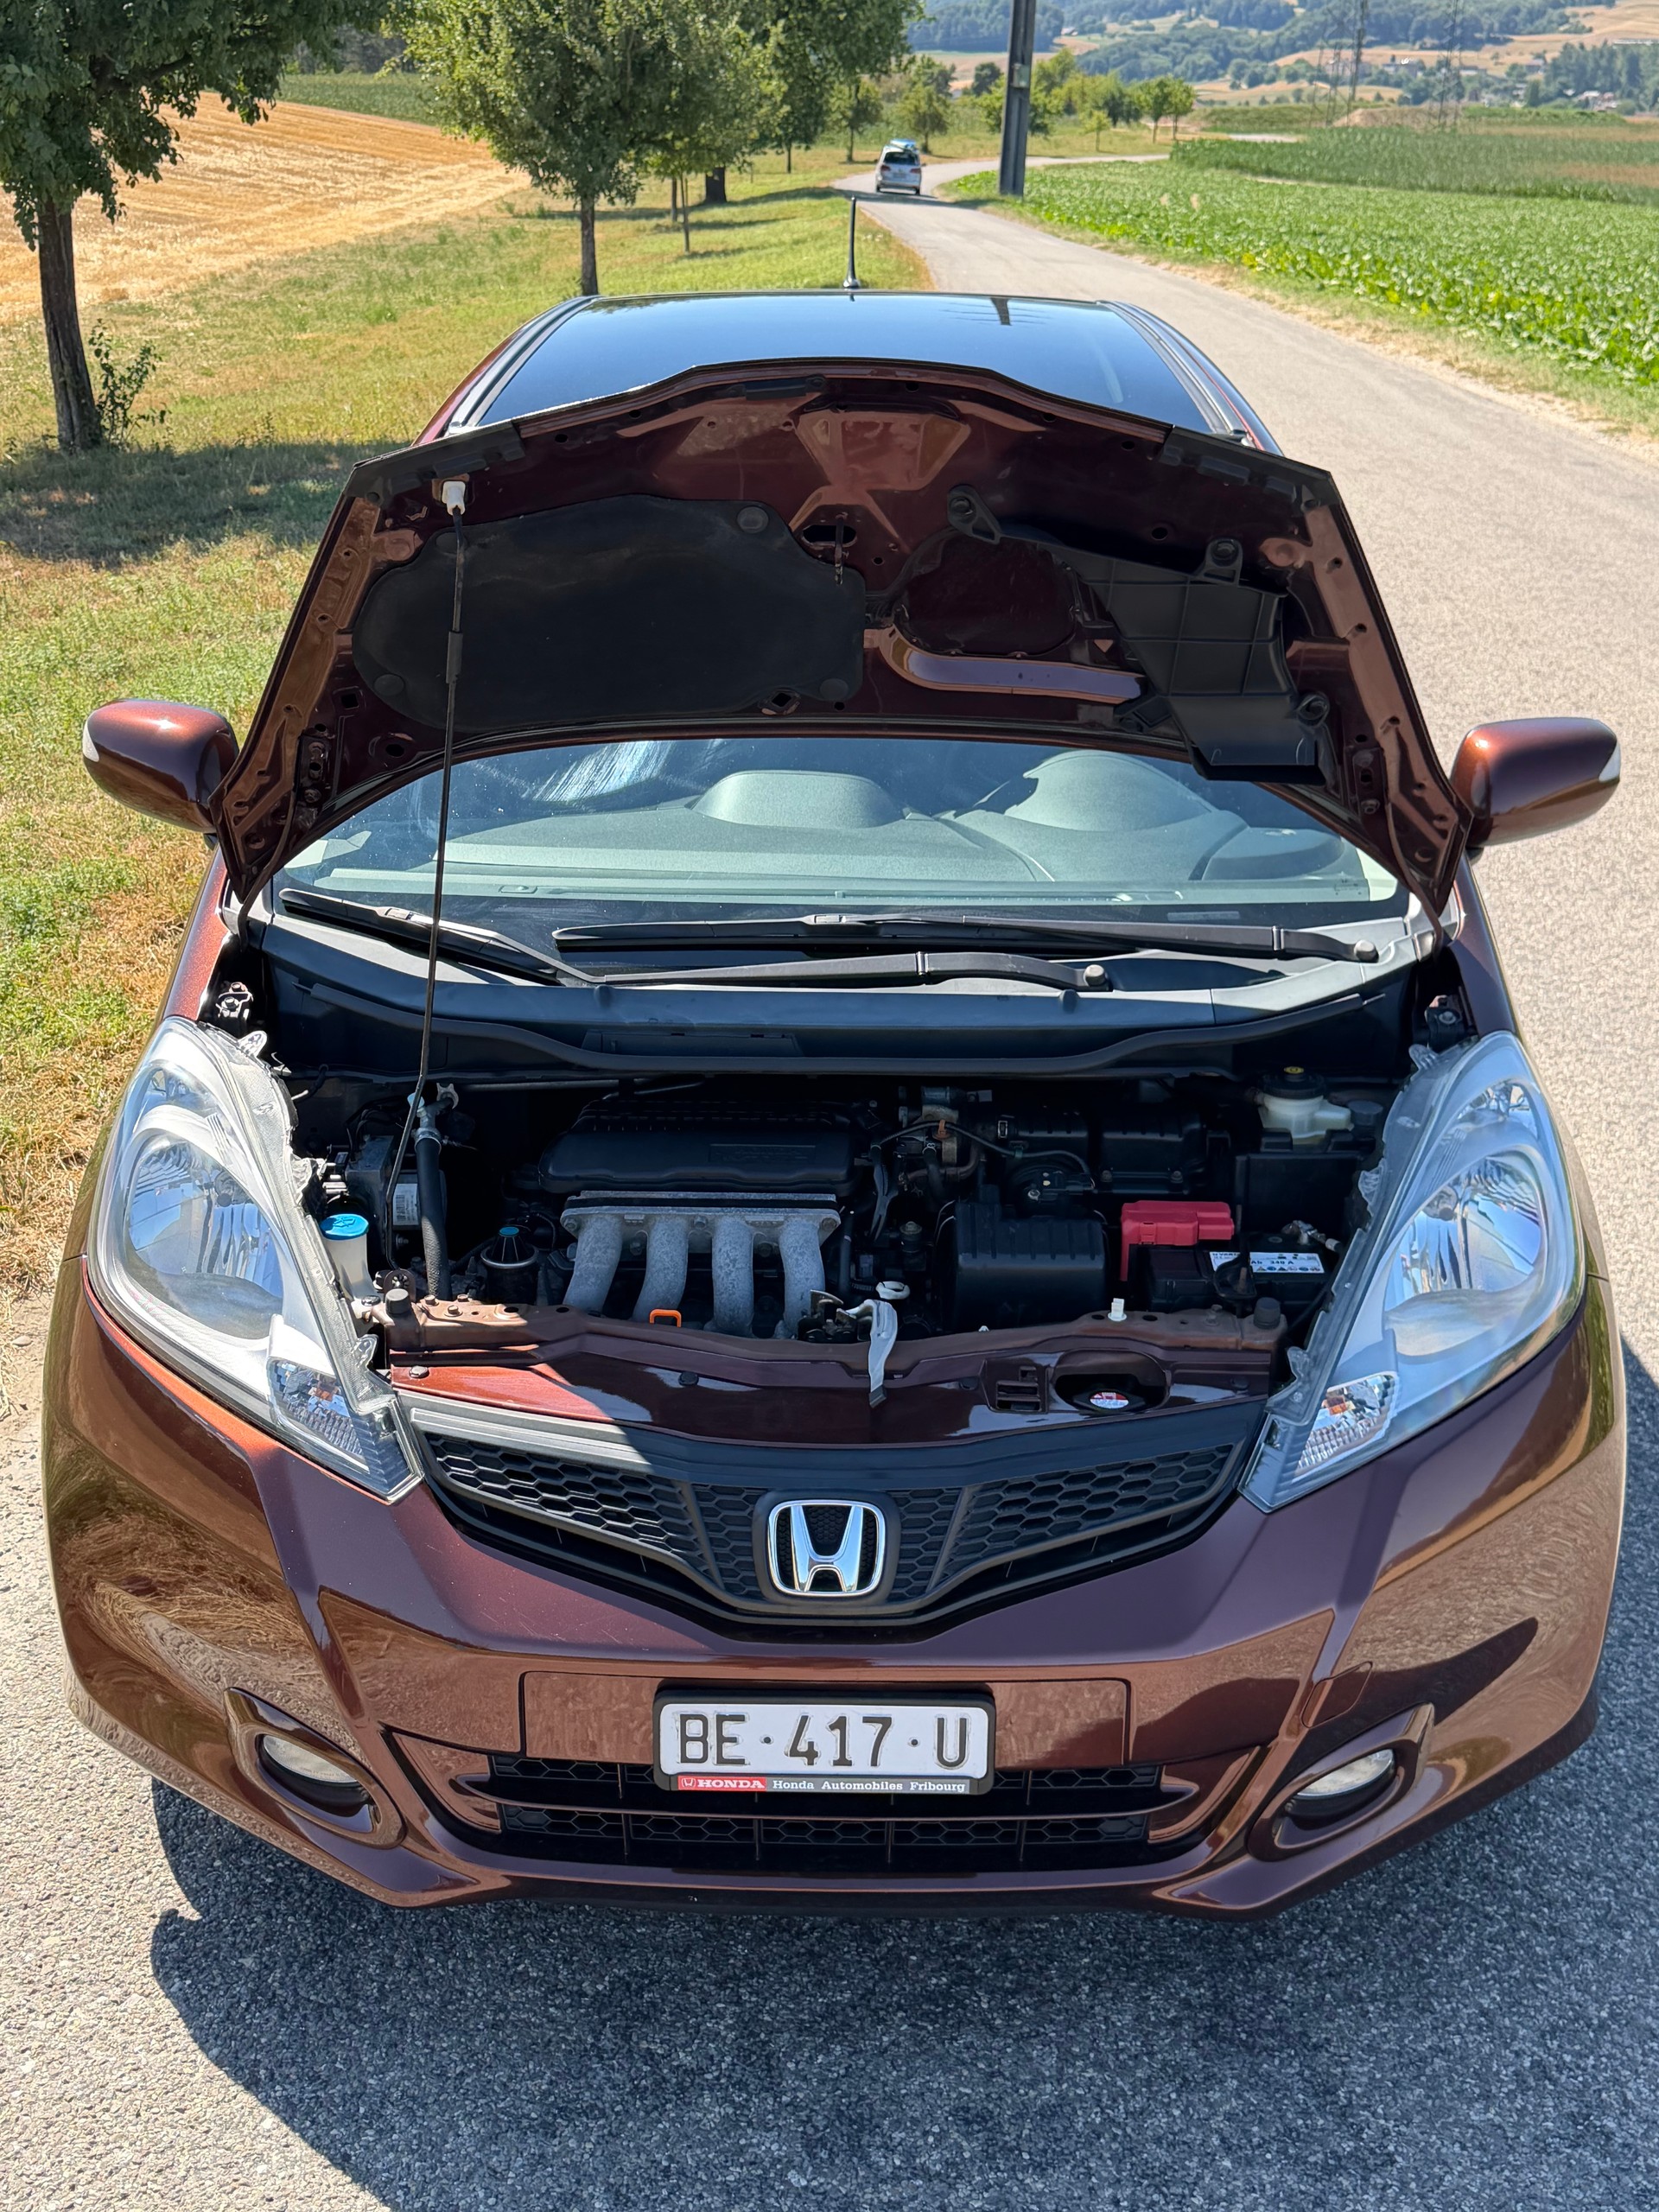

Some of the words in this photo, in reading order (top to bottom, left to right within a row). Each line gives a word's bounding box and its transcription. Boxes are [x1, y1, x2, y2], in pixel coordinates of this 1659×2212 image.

[678, 1713, 747, 1765] BE
[787, 1713, 893, 1768] 417
[936, 1716, 969, 1768] U
[697, 1779, 766, 1789] HONDA
[772, 1780, 815, 1789] Honda
[821, 1780, 903, 1790] Automobiles
[910, 1781, 966, 1792] Fribourg
